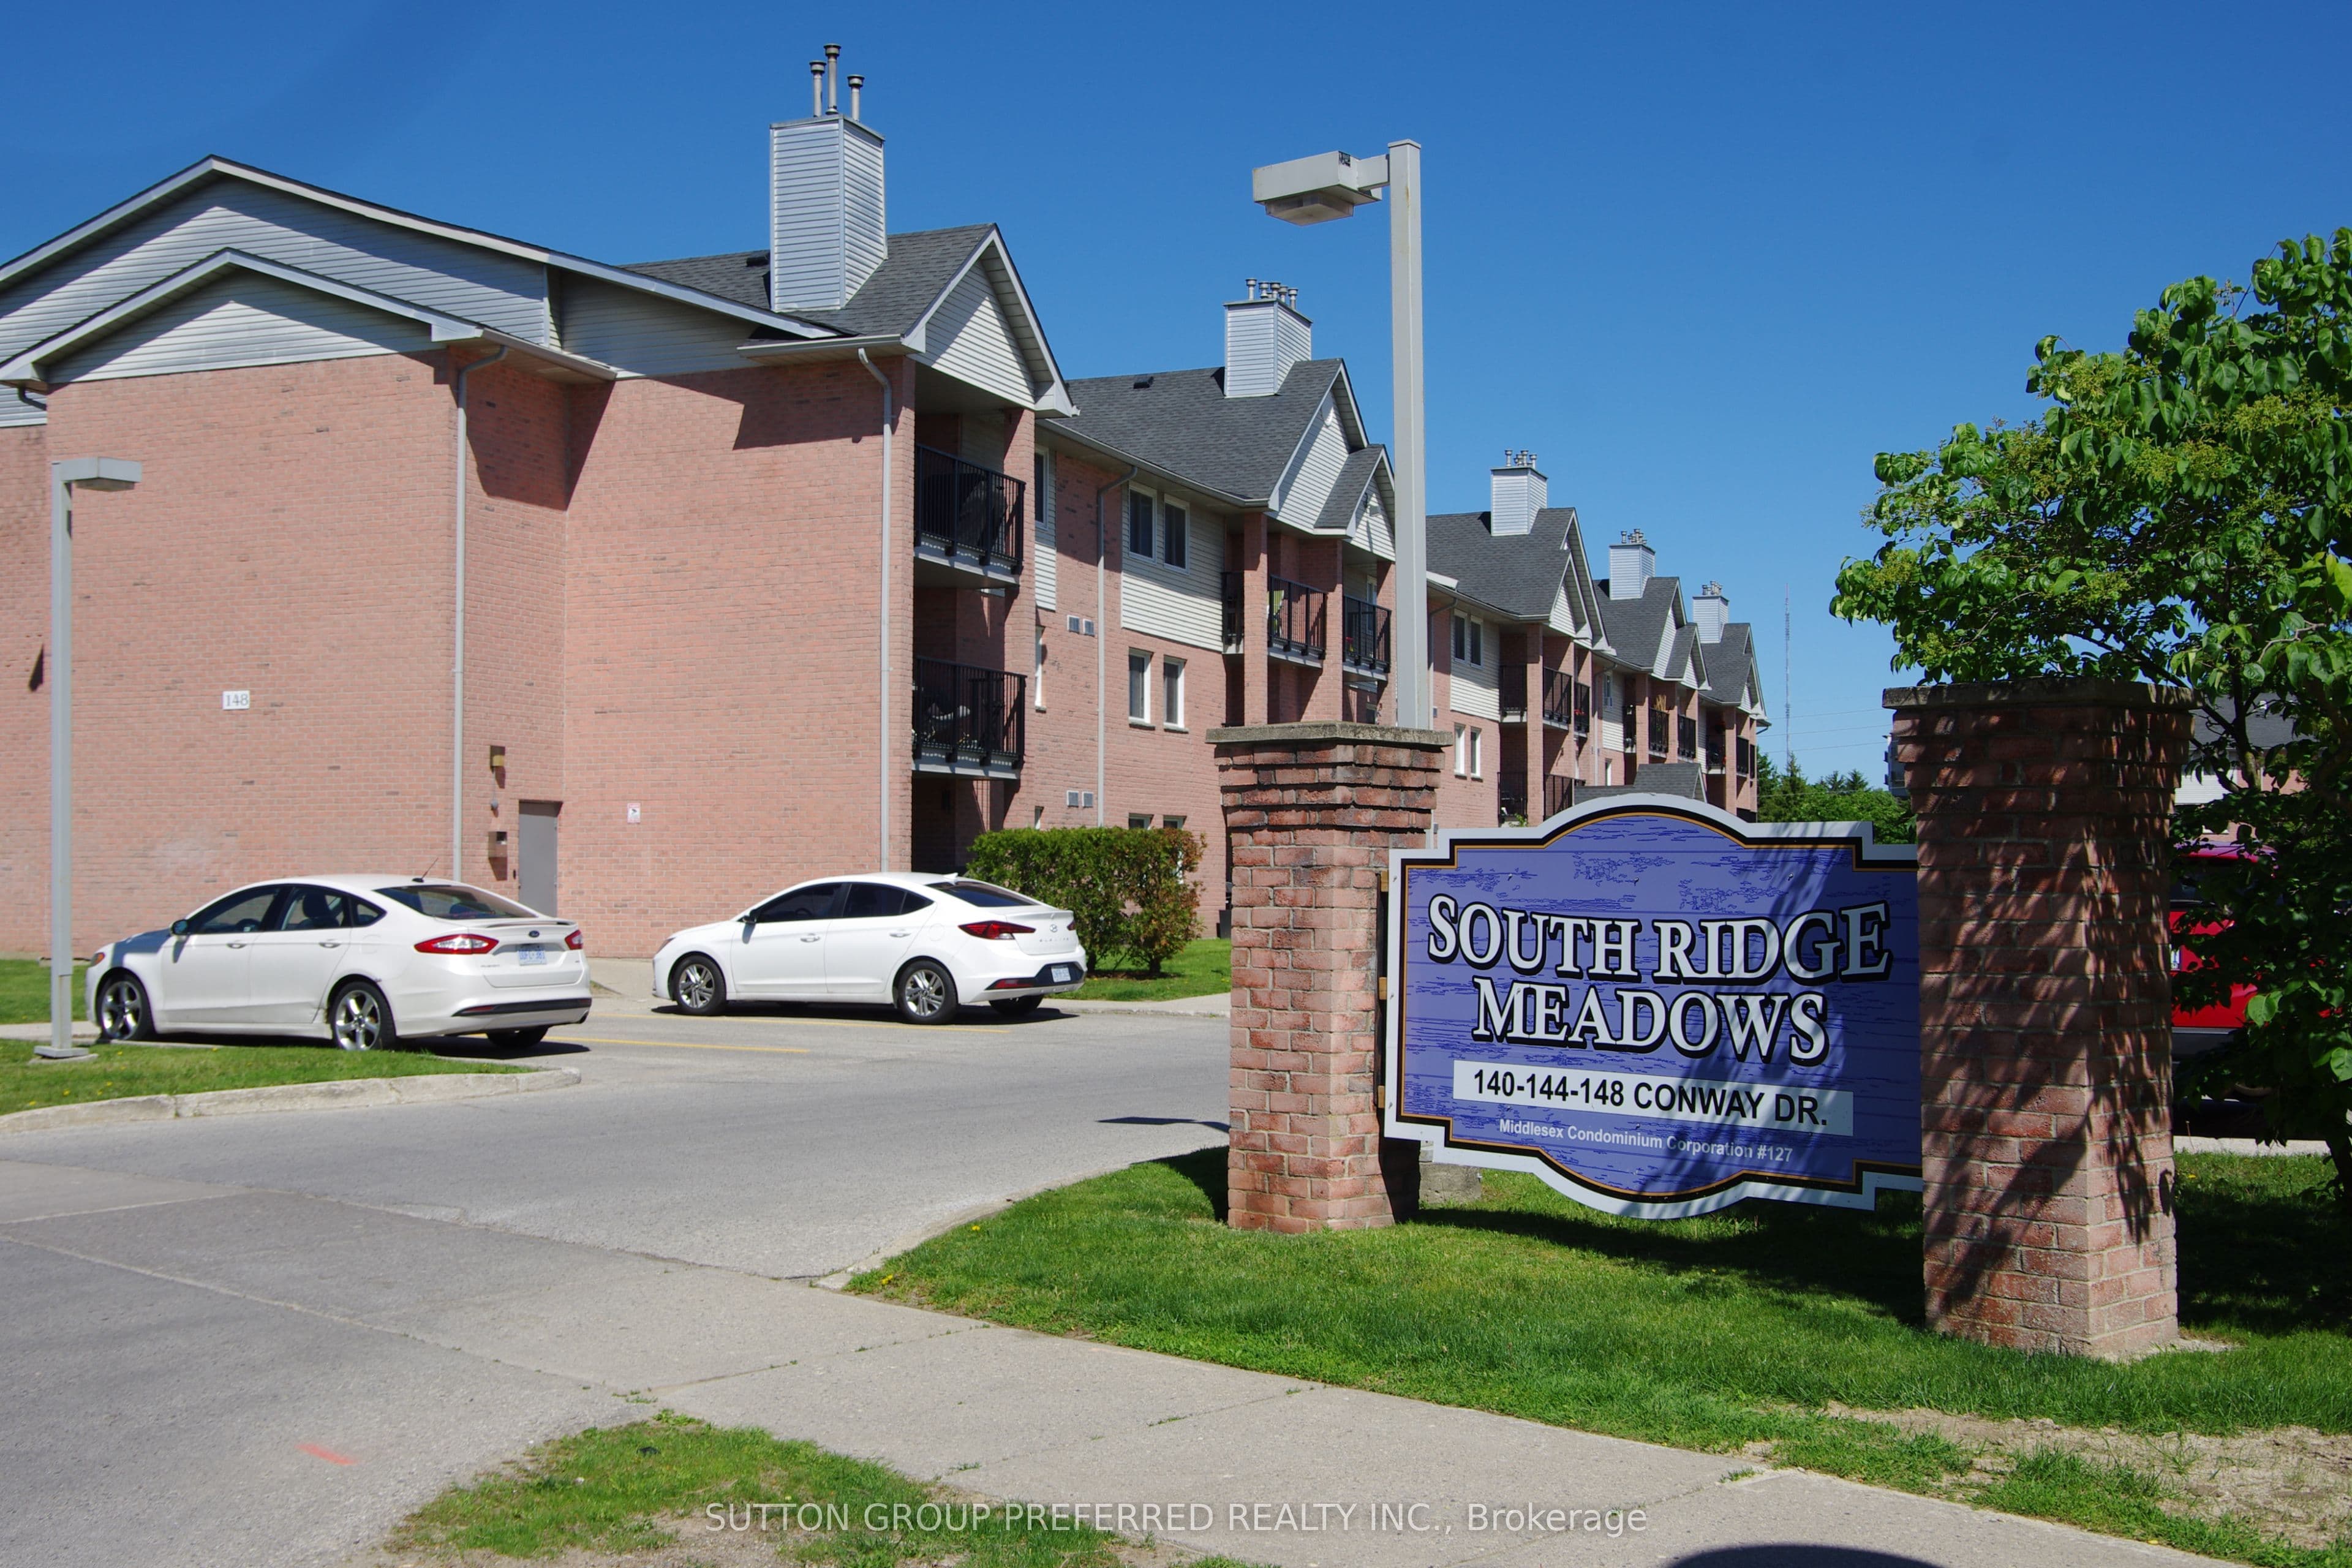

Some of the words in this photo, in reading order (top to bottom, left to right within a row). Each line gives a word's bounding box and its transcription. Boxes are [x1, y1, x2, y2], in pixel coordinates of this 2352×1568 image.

[225, 693, 249, 706] 148
[1428, 893, 1642, 982] SOUTH
[1652, 900, 1893, 986] RIDGE
[1471, 975, 1830, 1066] MEADOWS
[1474, 1069, 1624, 1107] 140-144-148
[1634, 1082, 1765, 1119] CONWAY
[1774, 1093, 1827, 1126] DR.
[1499, 1118, 1564, 1139] Middlesex
[1567, 1125, 1663, 1149] Condominium
[1666, 1135, 1753, 1158] Corporation
[1757, 1144, 1793, 1163] #127
